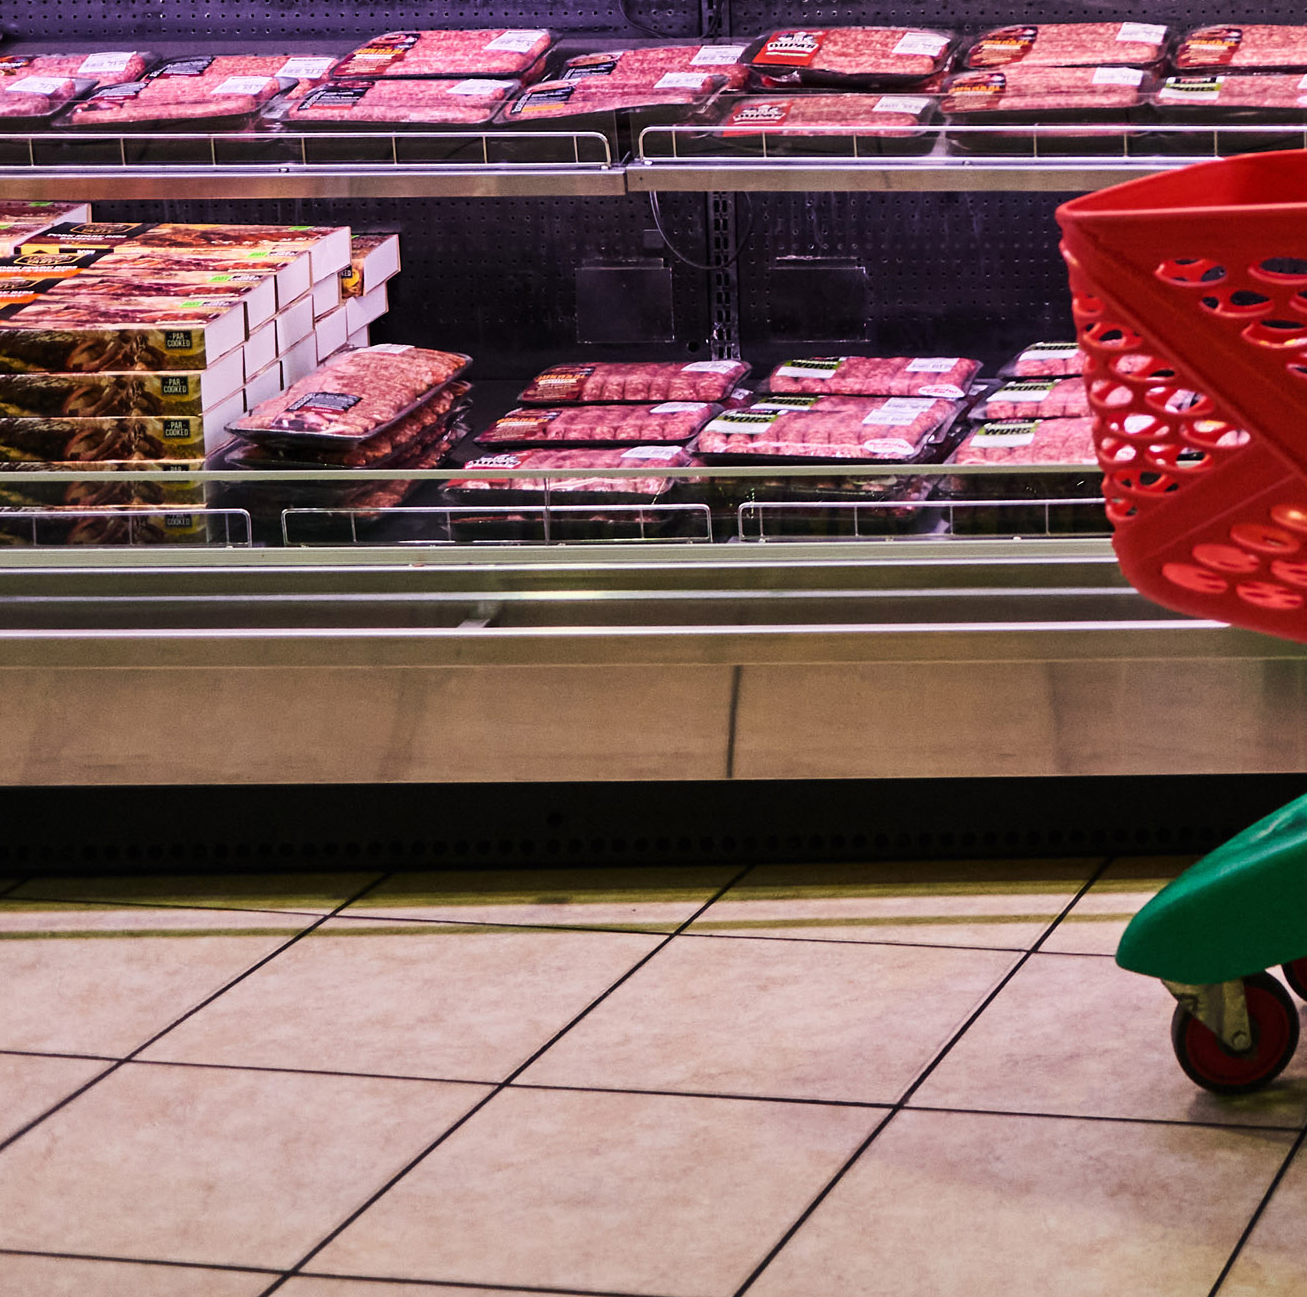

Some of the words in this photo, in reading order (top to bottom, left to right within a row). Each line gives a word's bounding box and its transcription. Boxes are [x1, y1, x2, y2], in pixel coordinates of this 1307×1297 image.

[172, 333, 185, 341] PAR
[166, 339, 191, 348] COOKED
[790, 360, 839, 369] WORS
[168, 378, 182, 386] PAR
[163, 385, 188, 394] COOKED
[1011, 383, 1056, 392] WORS
[719, 414, 777, 424] WORS
[170, 421, 183, 429] PAR
[165, 428, 189, 437] COOKED
[986, 426, 1032, 436] WORS
[167, 516, 191, 527] COOKED
